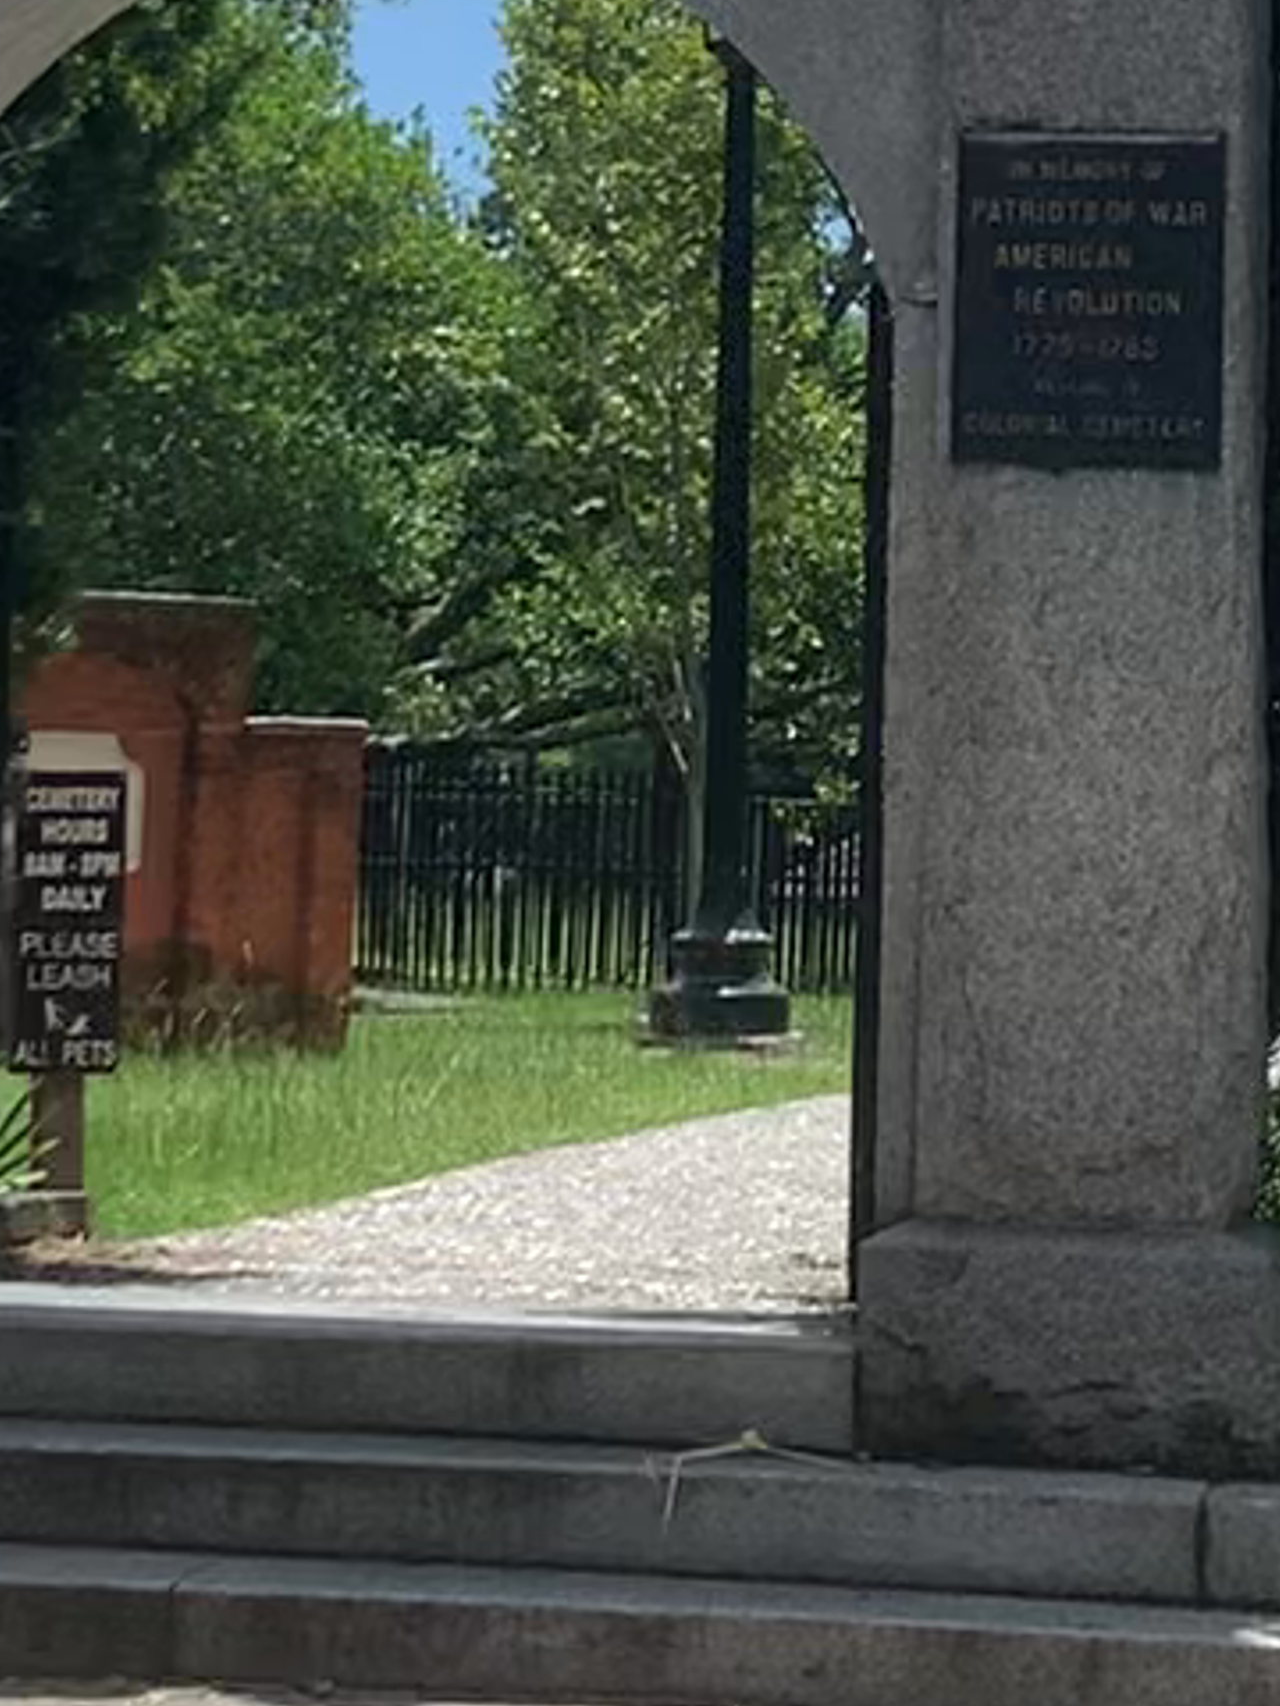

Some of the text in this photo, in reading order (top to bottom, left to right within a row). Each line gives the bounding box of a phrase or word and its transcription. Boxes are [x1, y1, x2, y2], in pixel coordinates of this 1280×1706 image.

[971, 197, 1208, 227] PATRIOTS OF WAR
[994, 242, 1133, 270] AMERICAN
[1013, 286, 1181, 316] REVOLUTION
[26, 787, 120, 813] CEMETERY
[41, 818, 108, 844] HOURS
[41, 885, 106, 911] DAILY
[19, 932, 118, 959] PLEASE
[26, 963, 112, 991] LEASH
[14, 1039, 117, 1066] ALL PETS
